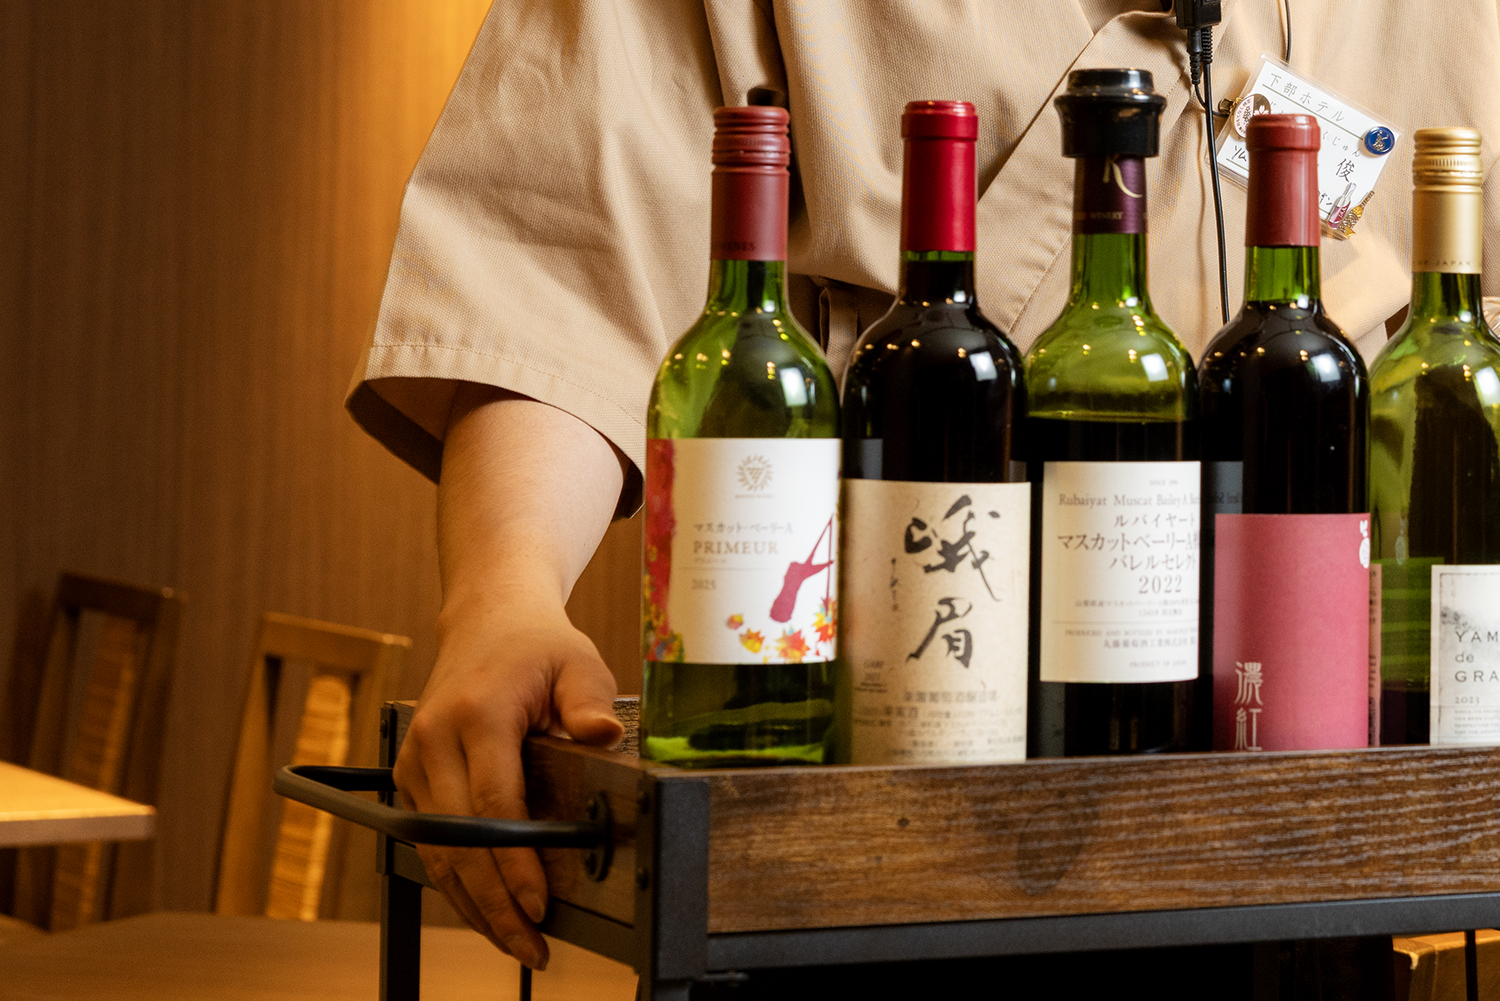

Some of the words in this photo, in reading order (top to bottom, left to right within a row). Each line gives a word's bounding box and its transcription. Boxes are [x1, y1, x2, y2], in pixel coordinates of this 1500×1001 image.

[1270, 72, 1345, 122] 下部ホテル
[1335, 158, 1355, 182] 俊
[1059, 493, 1106, 508] Rubaiyat
[1113, 493, 1152, 506] Muscat
[1156, 493, 1181, 508] Bailey
[1114, 512, 1195, 528] ルバイヤート
[693, 540, 778, 555] PRIMEUR
[1109, 554, 1196, 571] バレルセレクト
[1138, 574, 1182, 594] 2022
[1454, 651, 1474, 663] de
[1234, 661, 1264, 751] 濃紅
